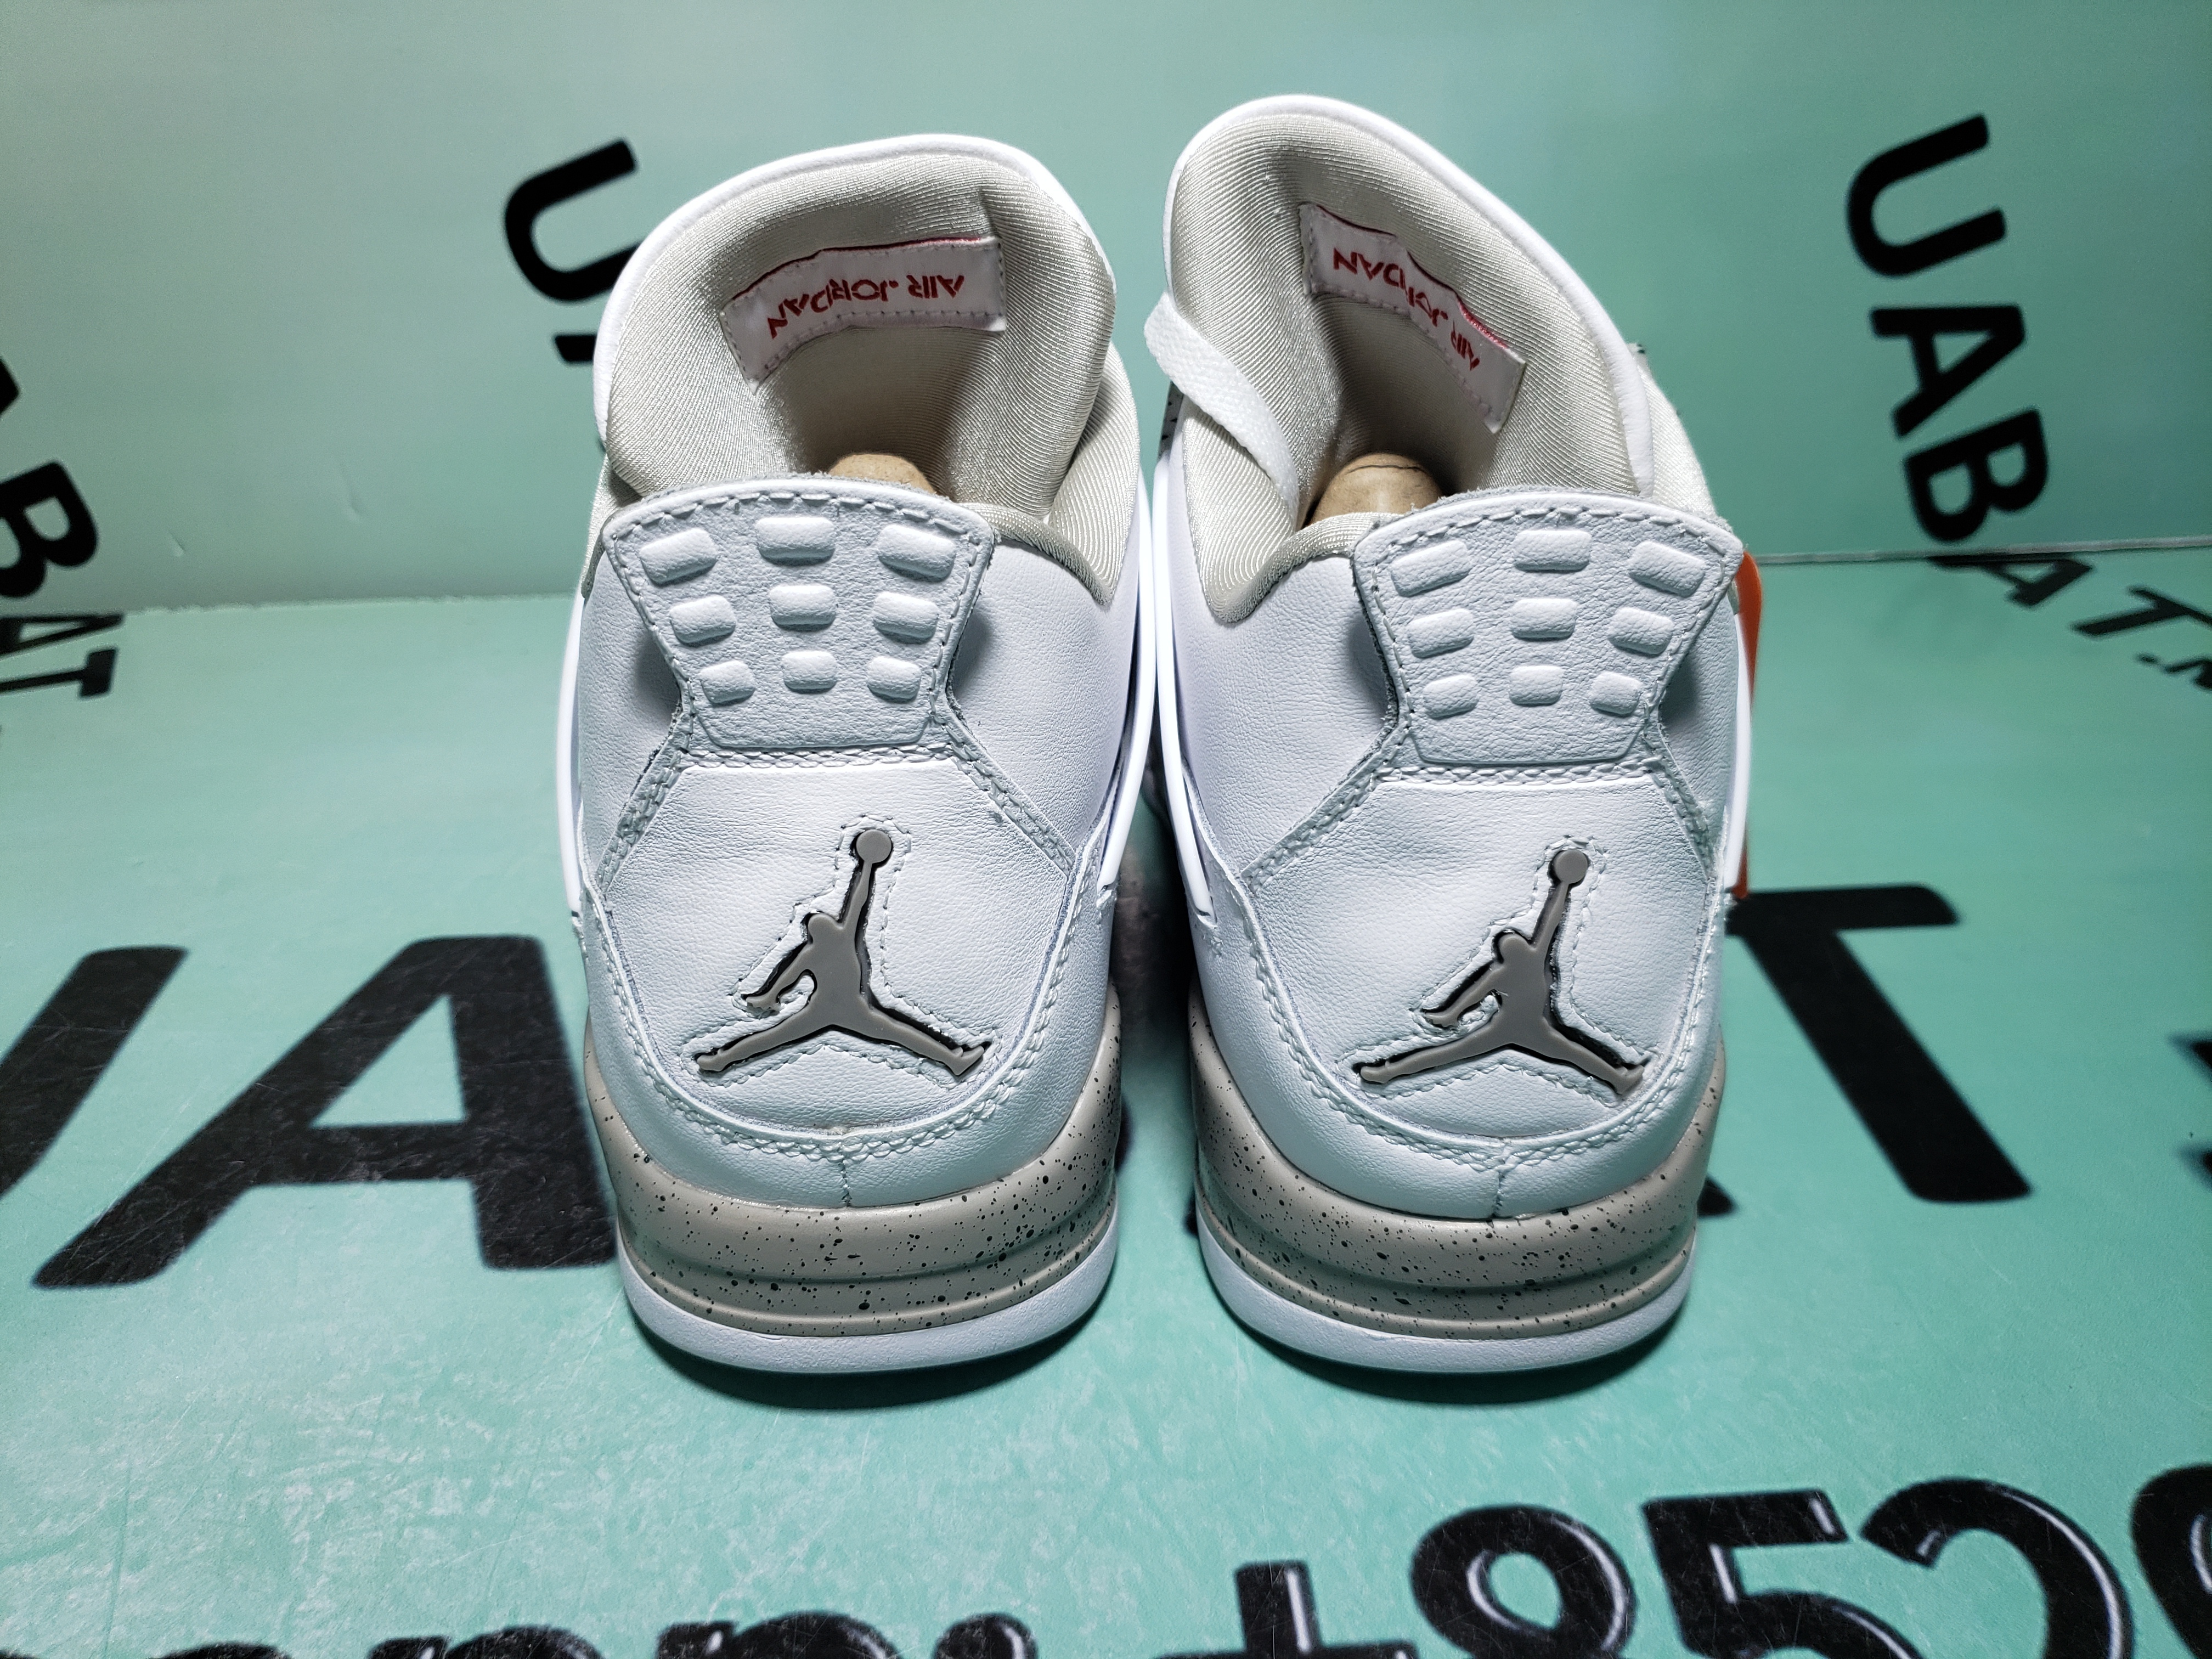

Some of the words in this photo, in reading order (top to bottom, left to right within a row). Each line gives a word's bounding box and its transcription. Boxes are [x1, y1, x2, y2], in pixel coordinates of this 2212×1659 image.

[768, 278, 899, 338] JORDAN
[907, 274, 964, 298] AIR
[1333, 247, 1448, 327] JORDAN
